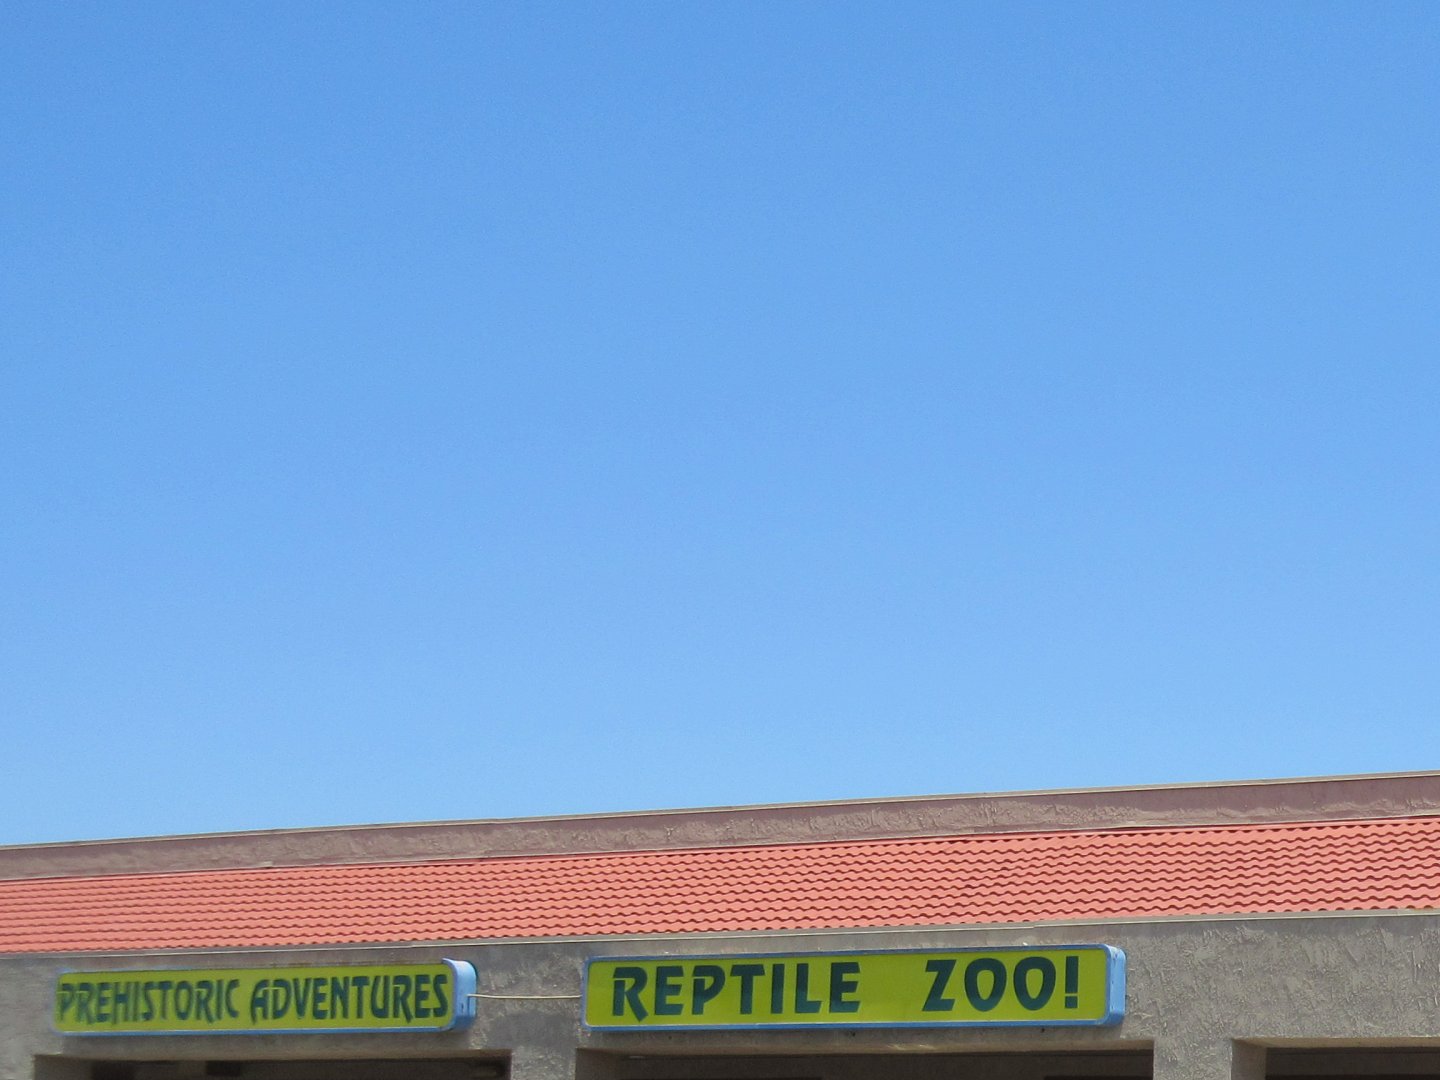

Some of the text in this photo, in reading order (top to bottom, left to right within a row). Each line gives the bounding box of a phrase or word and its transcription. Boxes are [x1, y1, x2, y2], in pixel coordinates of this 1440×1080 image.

[57, 974, 449, 1026] PREHISTORIC ADVENTURES
[611, 955, 1080, 1022] REPTILE ZOO!
